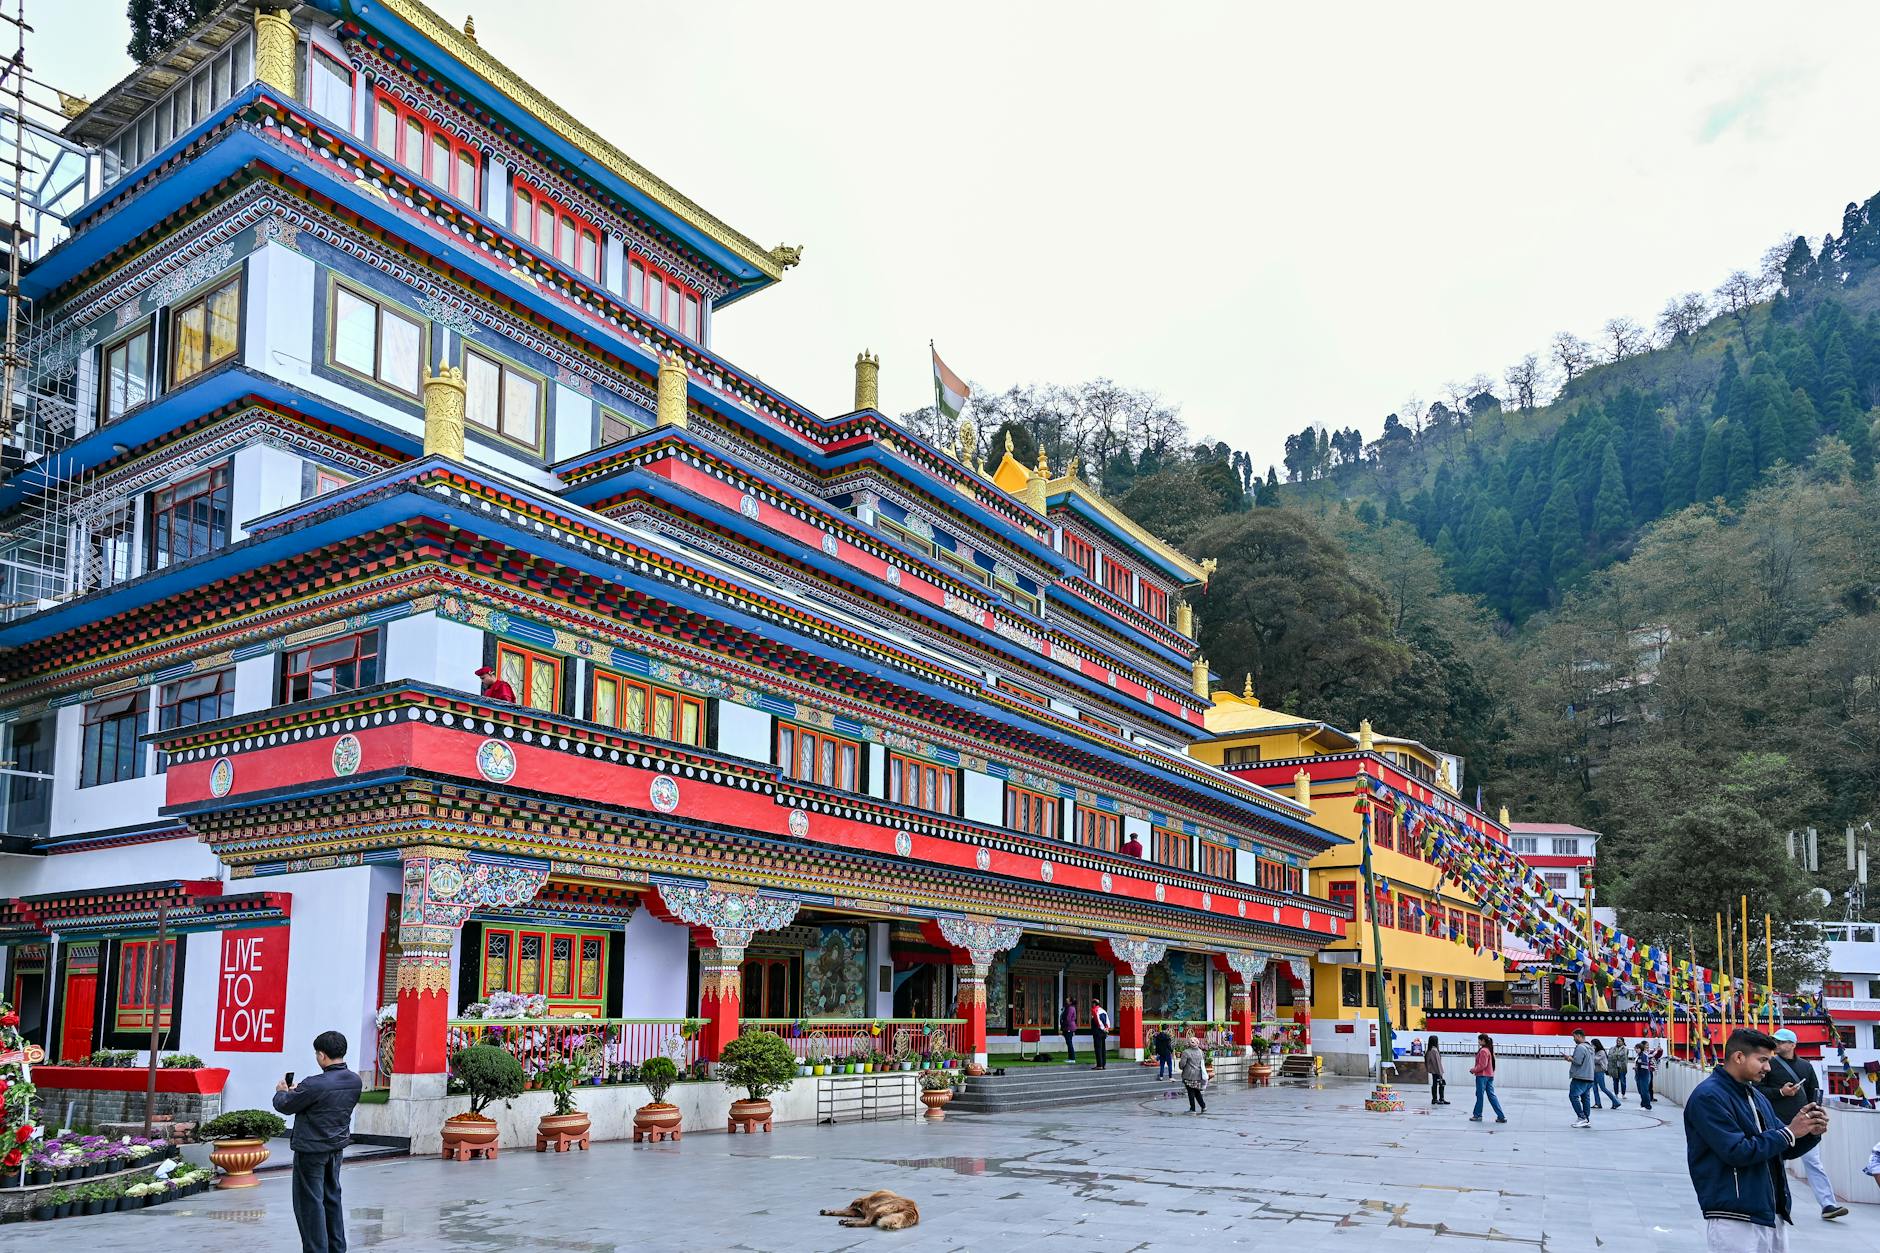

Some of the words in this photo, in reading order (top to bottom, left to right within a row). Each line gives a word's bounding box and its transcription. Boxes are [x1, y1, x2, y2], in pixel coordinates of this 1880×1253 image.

[224, 937, 264, 972] LIVE
[223, 973, 254, 1007] TO
[219, 1008, 275, 1043] LOVE
